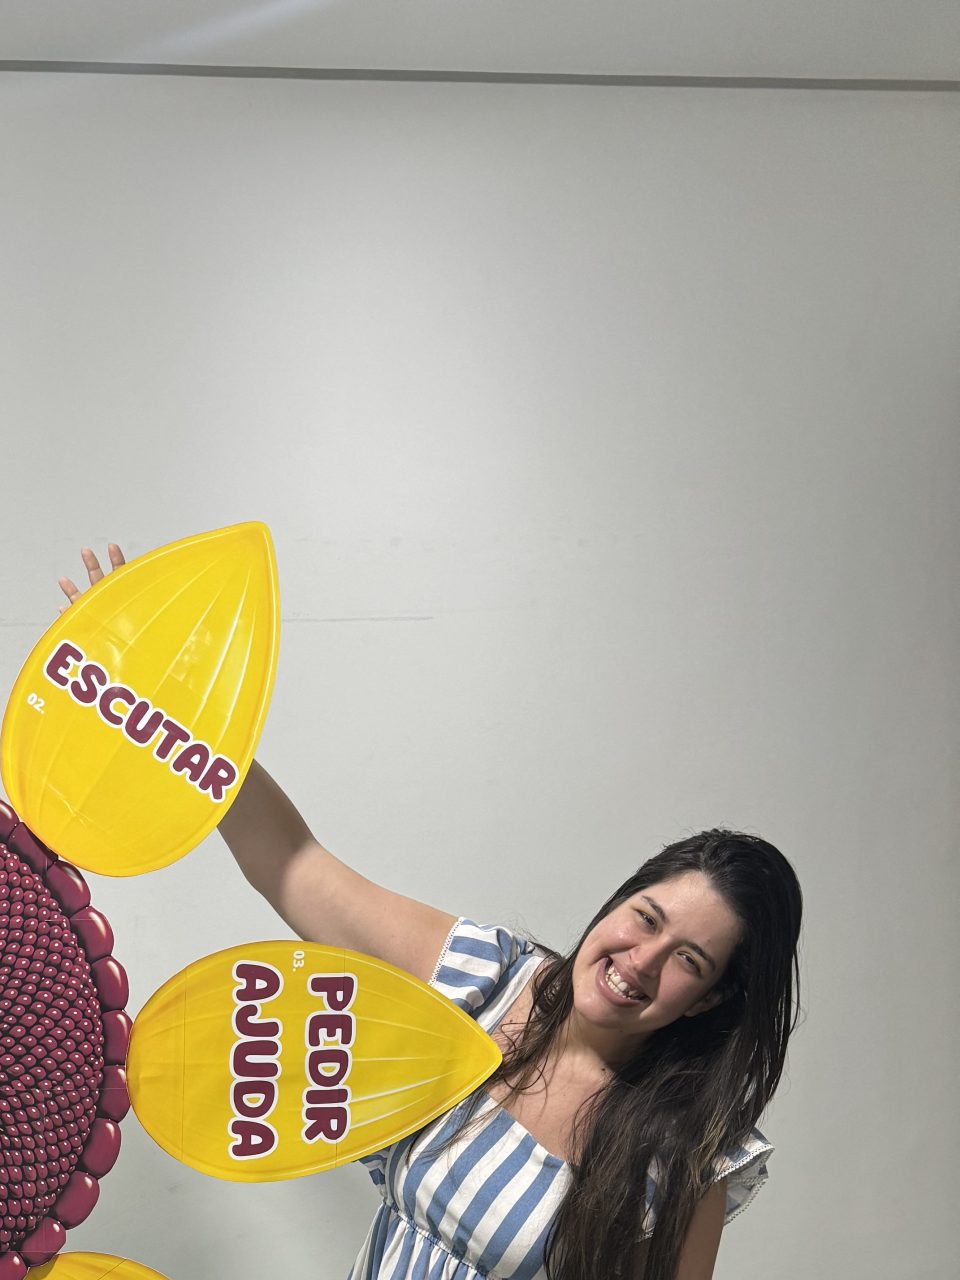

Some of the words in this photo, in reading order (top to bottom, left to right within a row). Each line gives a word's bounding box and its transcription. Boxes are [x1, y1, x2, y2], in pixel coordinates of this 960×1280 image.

[27, 693, 46, 715] 02.
[46, 641, 239, 801] ESCUTAR
[292, 950, 304, 972] 03.
[231, 962, 280, 1158] AJUDA
[304, 973, 356, 1143] PEDIR
